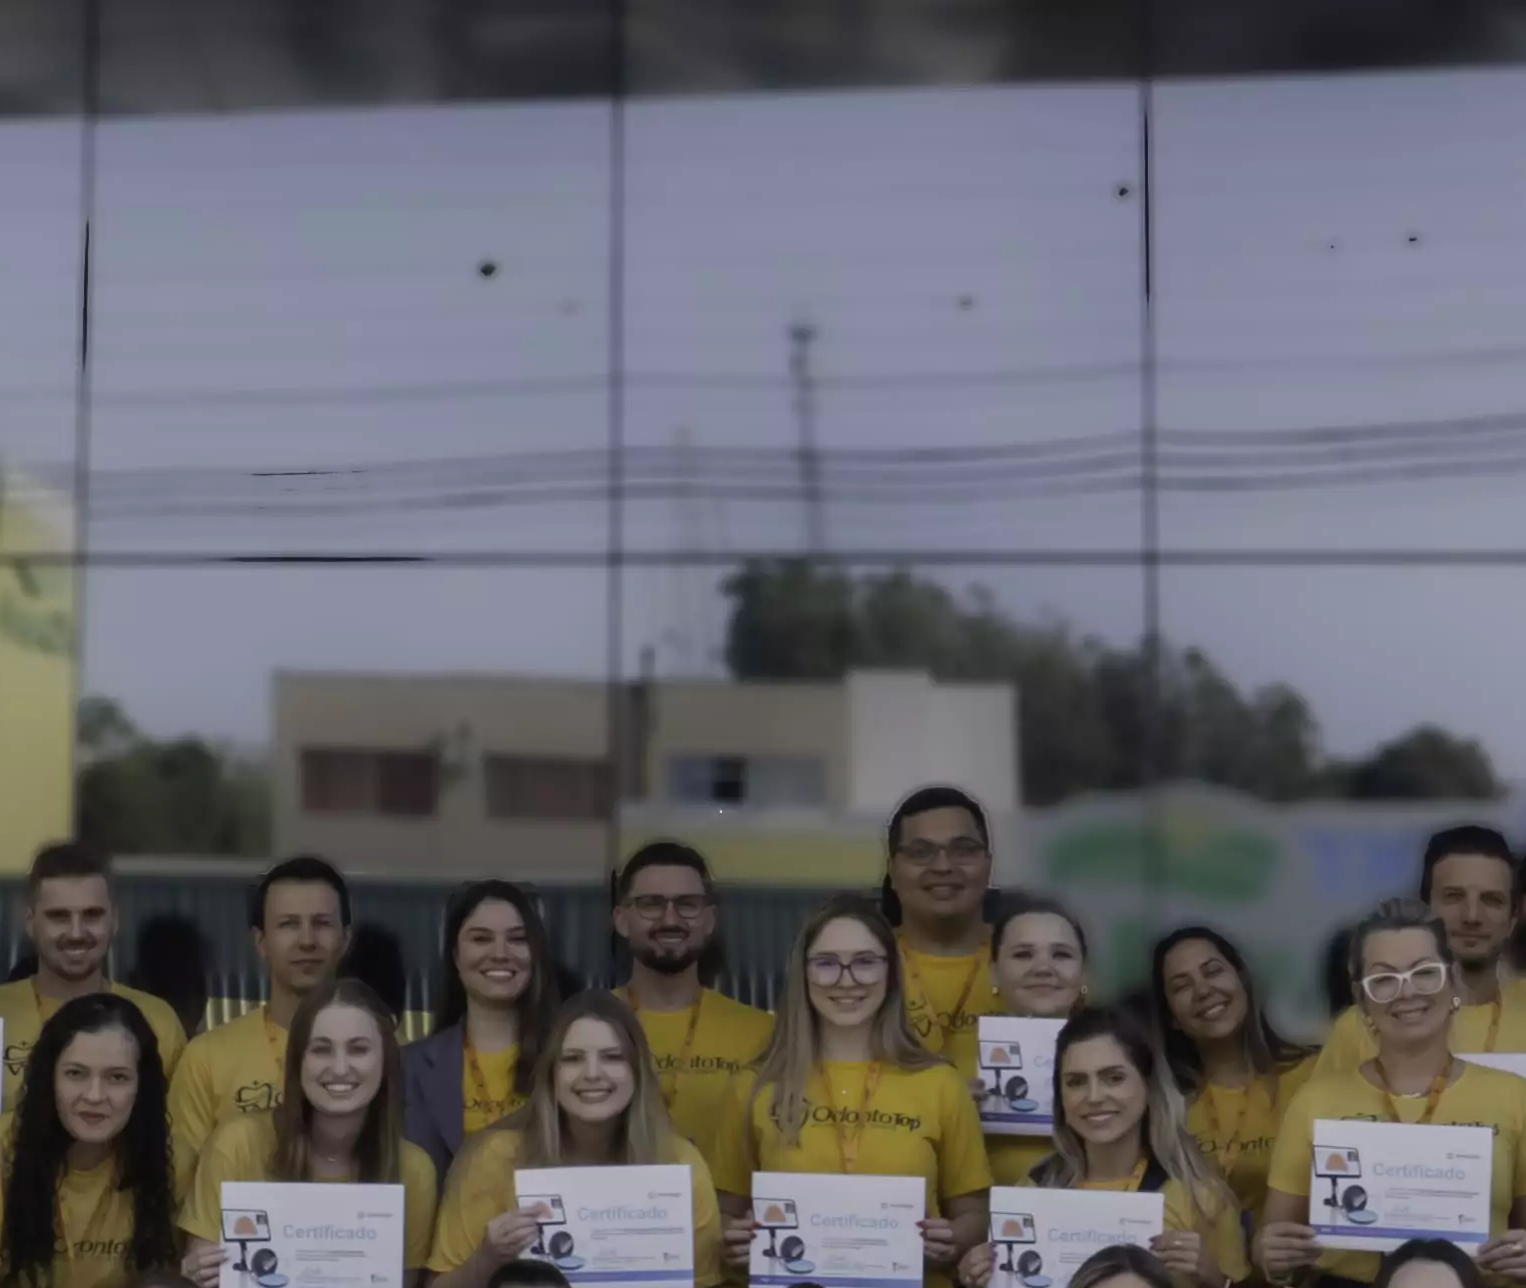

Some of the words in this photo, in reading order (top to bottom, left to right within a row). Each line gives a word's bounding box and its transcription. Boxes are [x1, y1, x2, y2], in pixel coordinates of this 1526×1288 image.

[1373, 1162, 1467, 1181] Certificado
[577, 1205, 669, 1222] Certificado
[809, 1213, 900, 1231] Certificado
[282, 1224, 378, 1240] Certificado
